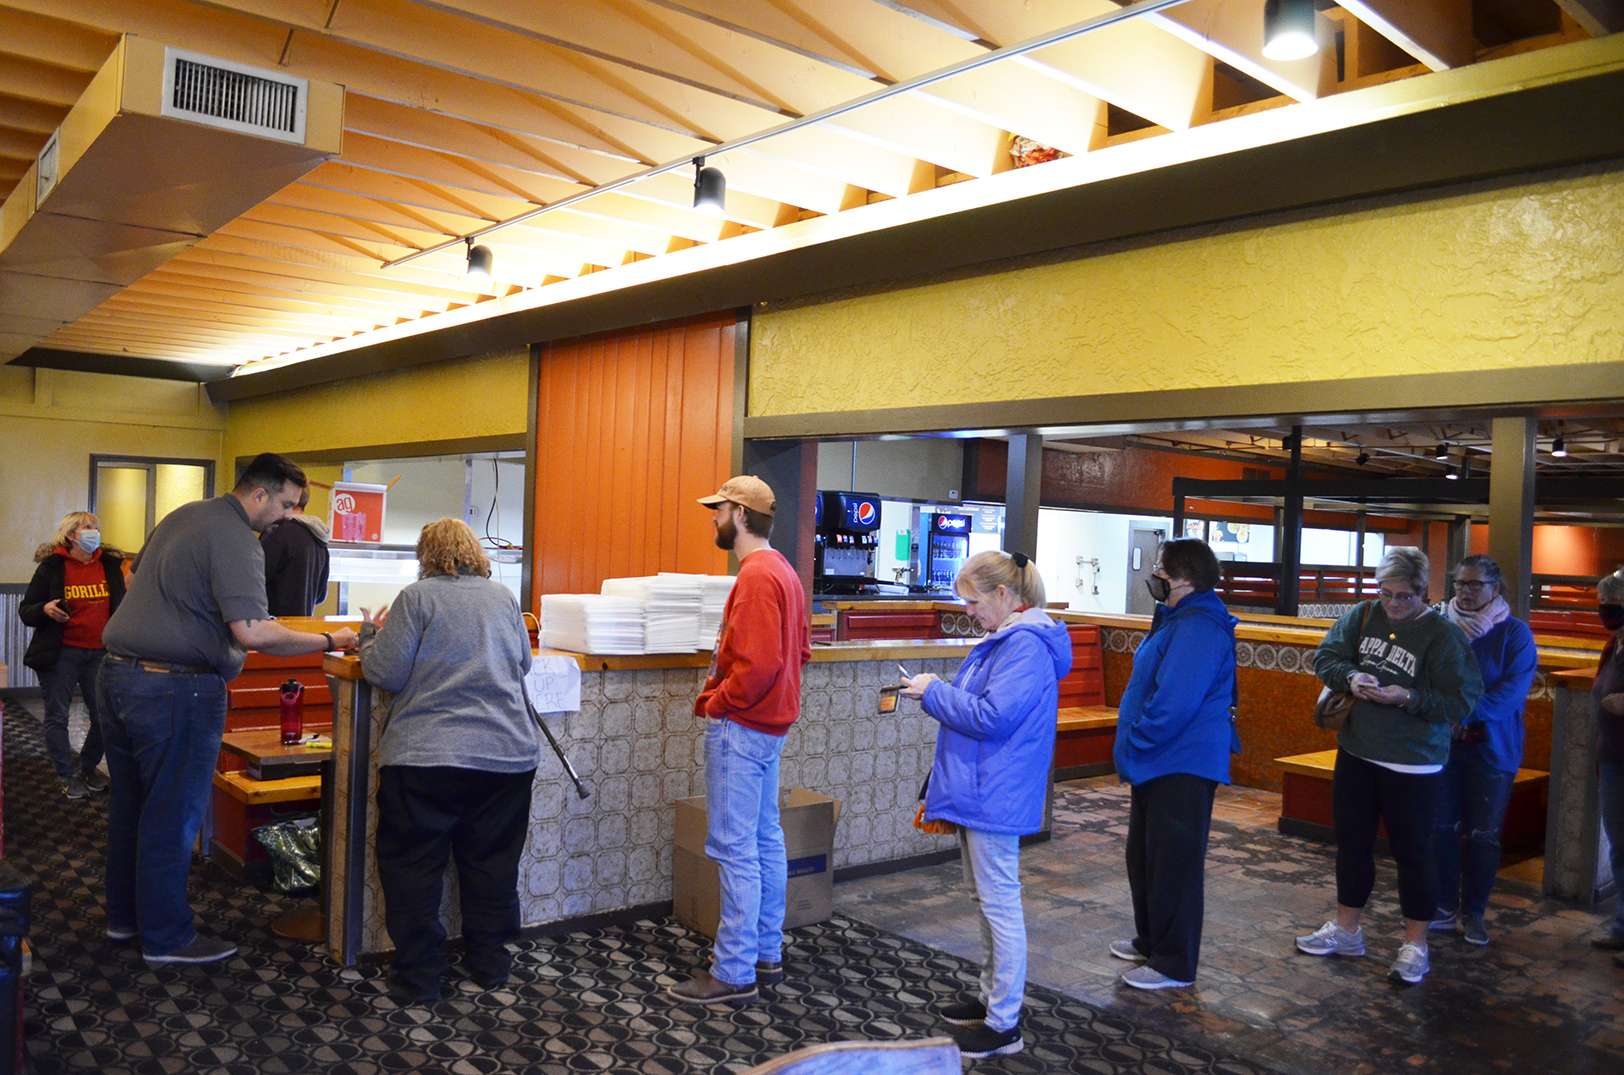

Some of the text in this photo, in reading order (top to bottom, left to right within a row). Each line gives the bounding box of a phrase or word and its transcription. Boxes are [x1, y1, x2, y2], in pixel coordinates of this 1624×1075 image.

[947, 518, 966, 529] pepsi
[64, 583, 110, 600] GORILL
[1359, 636, 1417, 678] APPA DELTA
[530, 658, 555, 676] CK
[533, 676, 554, 693] UP
